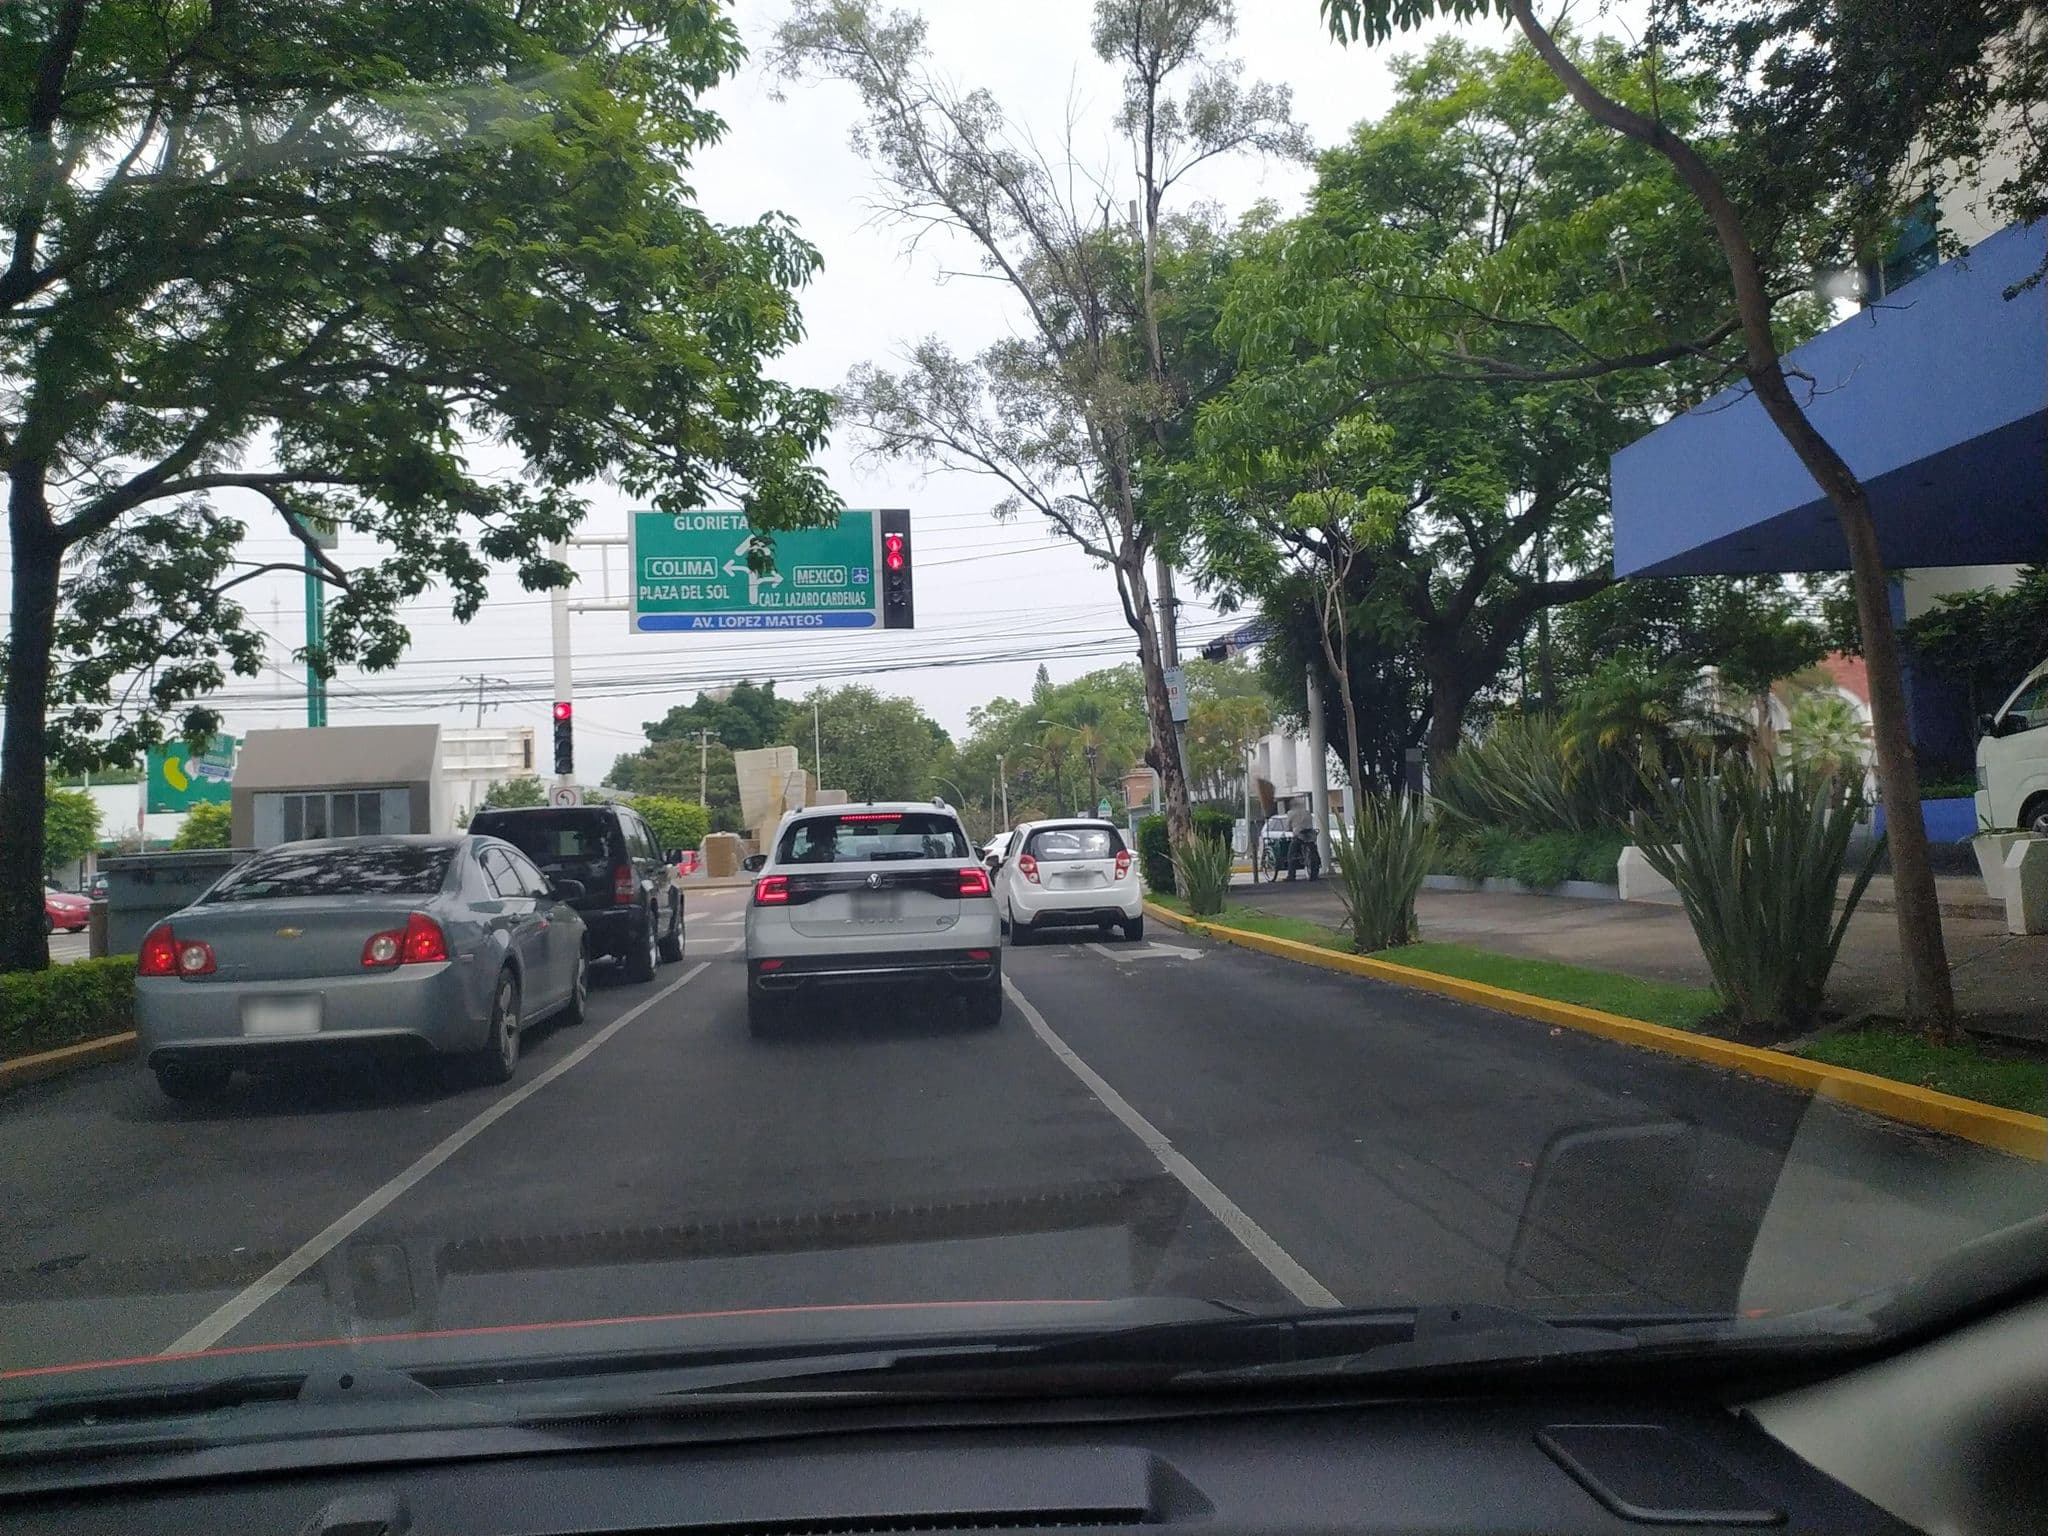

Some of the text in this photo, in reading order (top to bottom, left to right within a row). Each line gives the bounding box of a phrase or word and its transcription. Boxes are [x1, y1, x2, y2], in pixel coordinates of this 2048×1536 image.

[674, 516, 749, 531] GLORIETA
[652, 561, 714, 576] COLIMA
[797, 568, 844, 584] MEXICO
[640, 584, 730, 600] PLAZA DEL SOL
[760, 591, 866, 607] CALZ. LAZARO CARDENAS
[692, 614, 824, 628] AV. LOPEZ MATEOS
